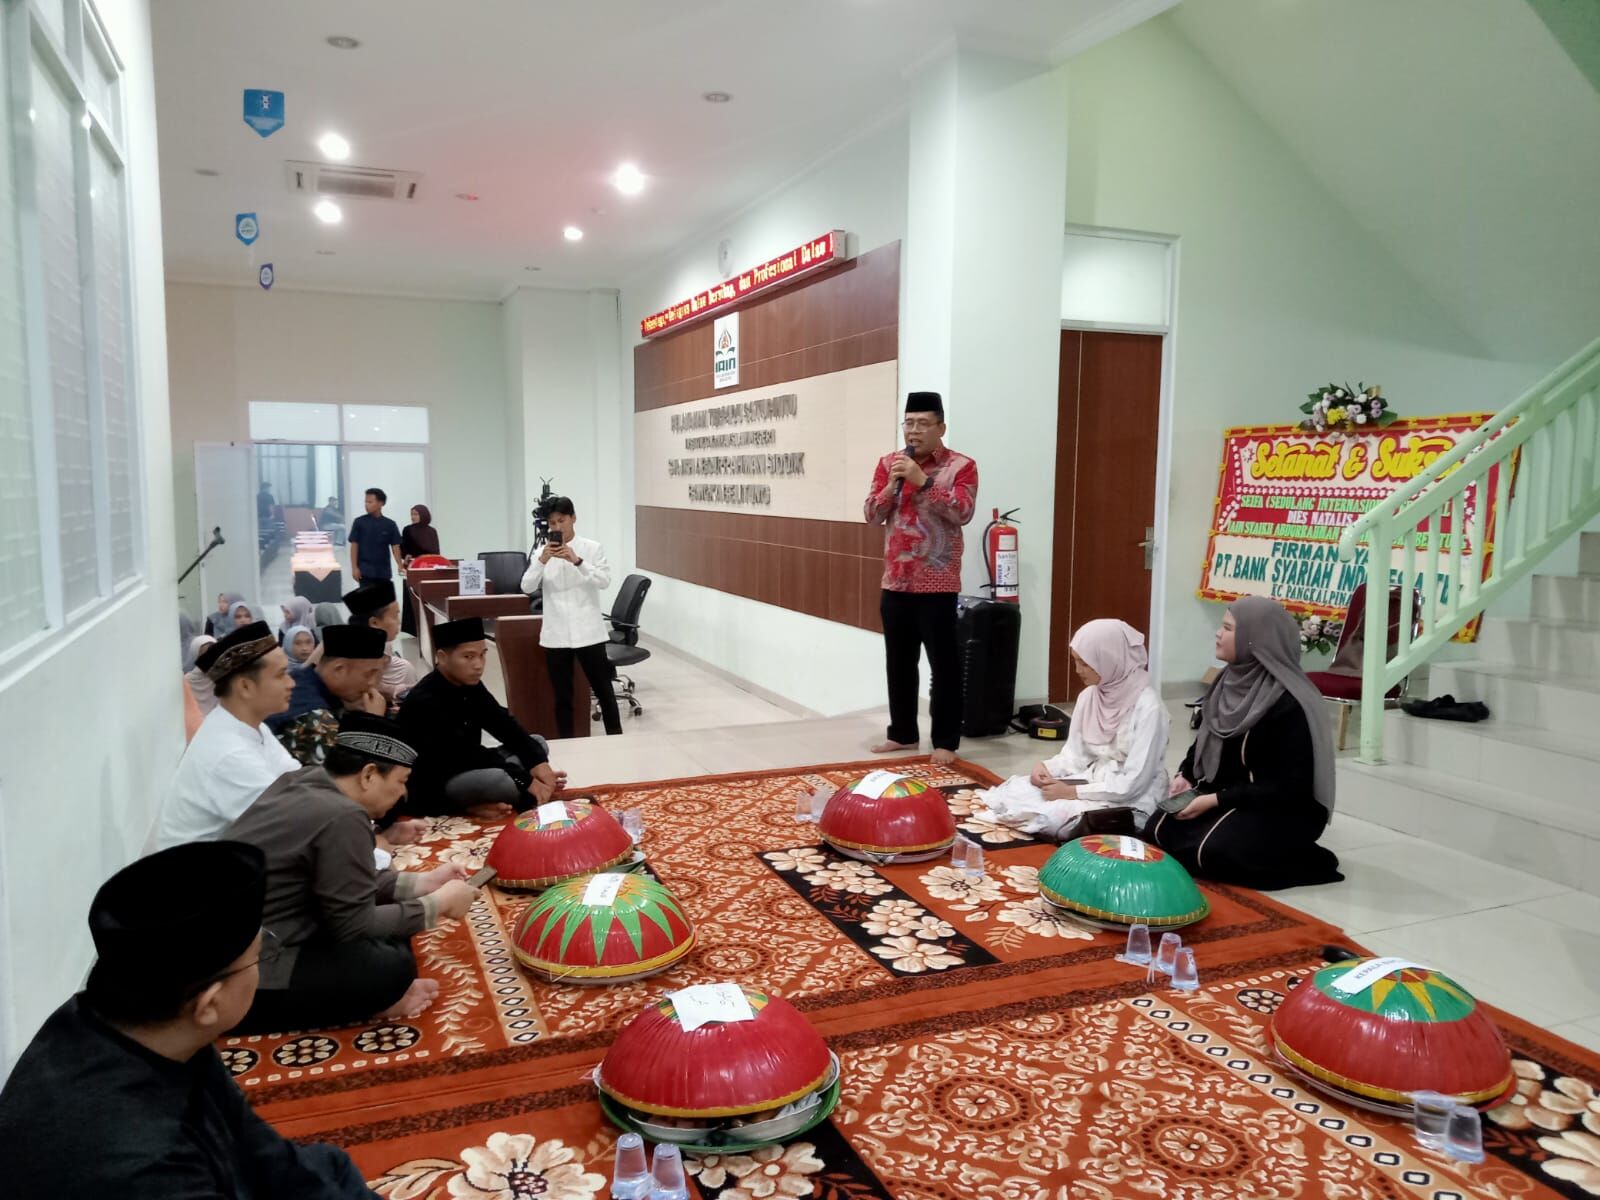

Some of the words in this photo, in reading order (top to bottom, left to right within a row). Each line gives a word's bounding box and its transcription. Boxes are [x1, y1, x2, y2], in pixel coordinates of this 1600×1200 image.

[1251, 441, 1342, 479] Selamat
[1342, 446, 1367, 479] &
[1311, 511, 1353, 527] NATALIS
[1213, 553, 1269, 583] PT.BANK
[1271, 558, 1335, 589] SYARIAH
